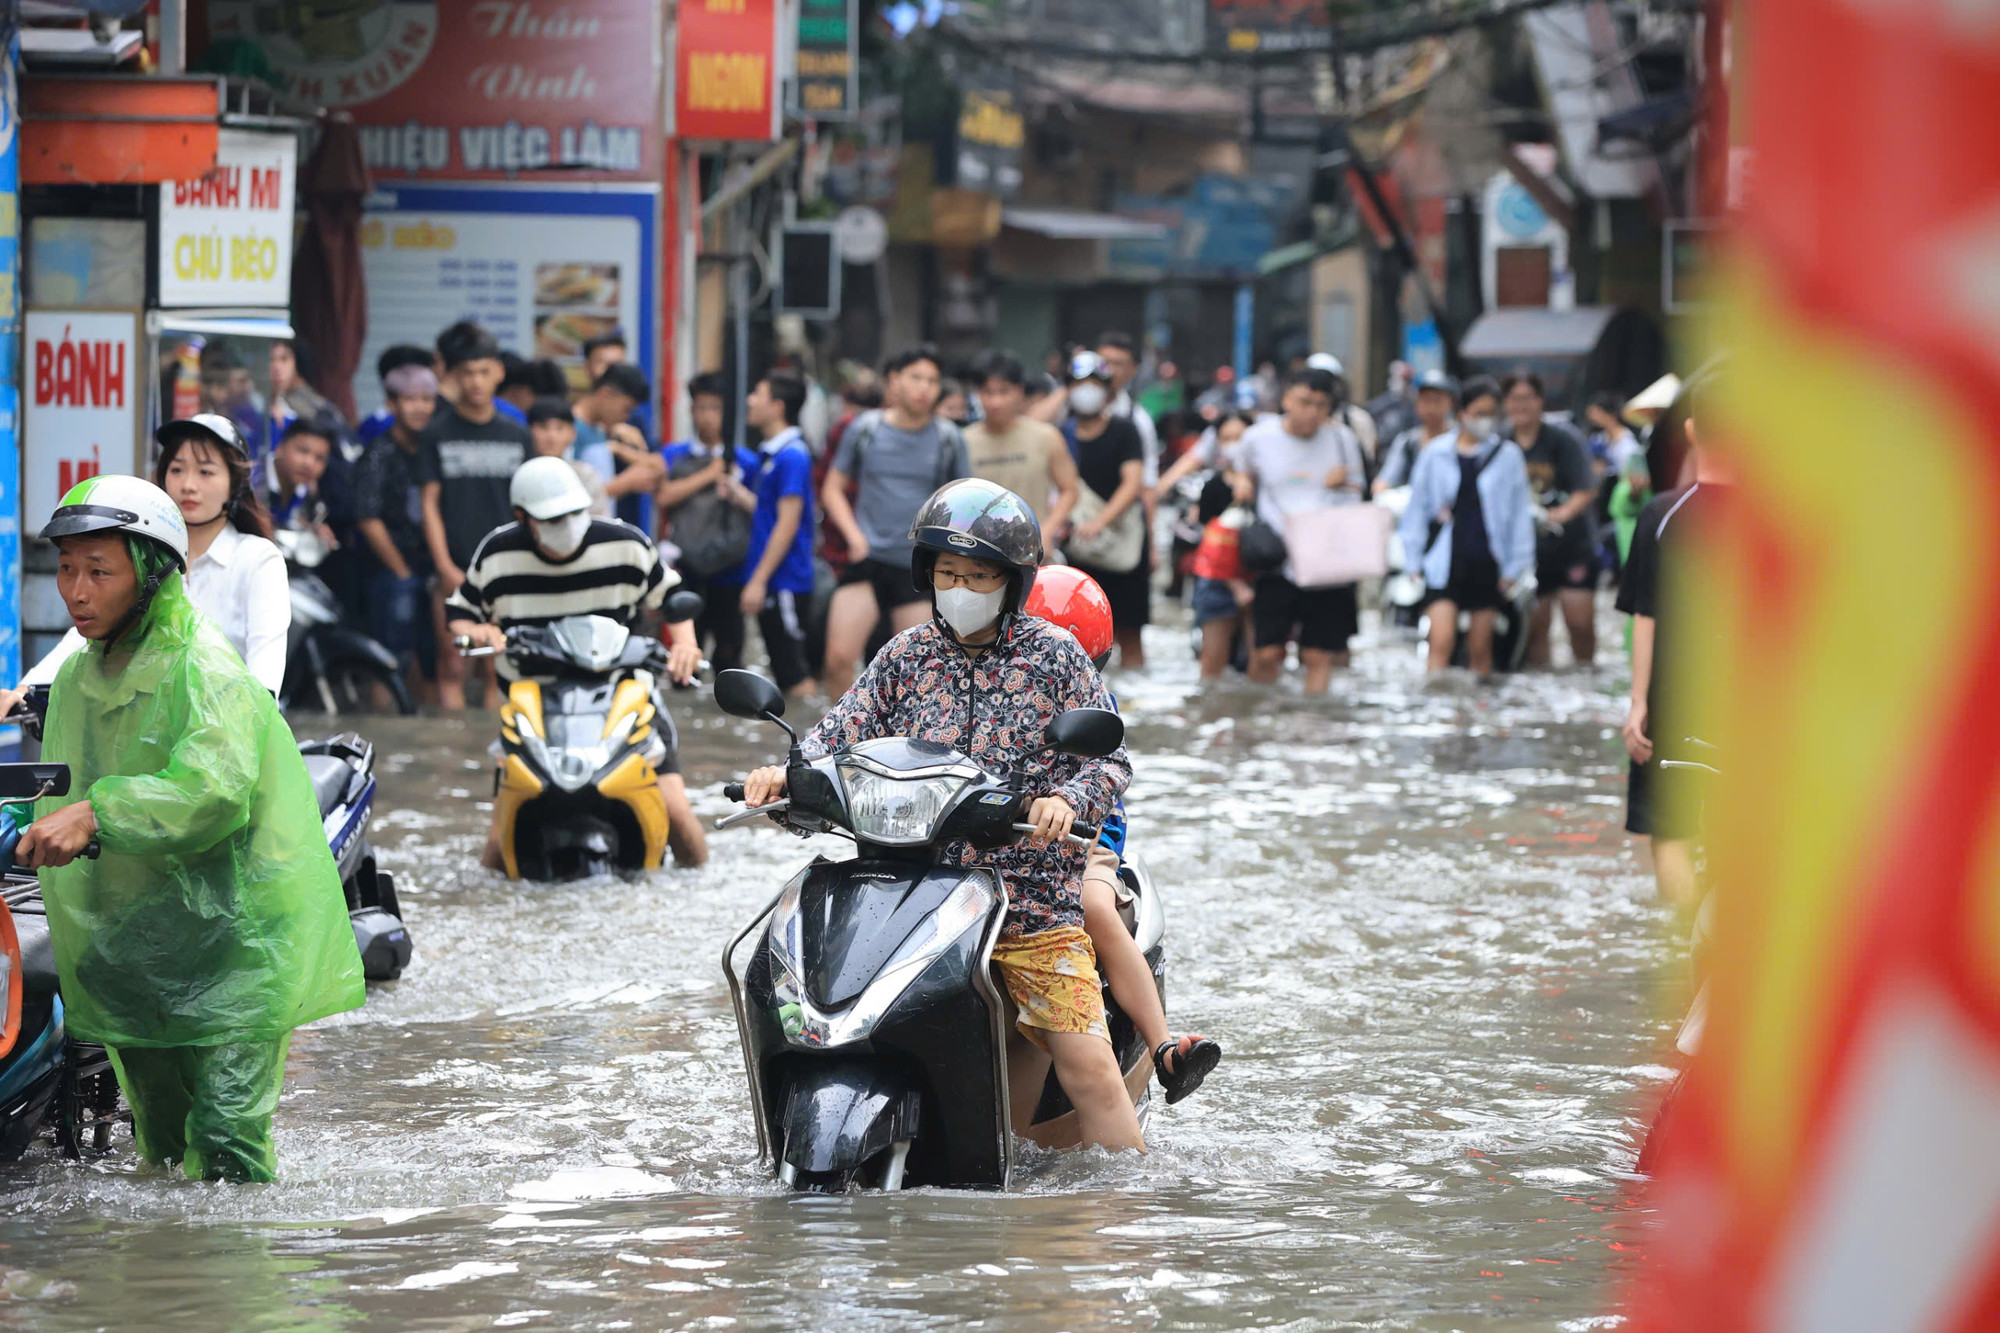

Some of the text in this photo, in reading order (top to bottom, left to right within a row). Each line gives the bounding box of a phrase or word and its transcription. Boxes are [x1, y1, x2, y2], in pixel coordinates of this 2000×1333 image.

[357, 119, 449, 177] HIỆU
[461, 119, 551, 178] VIỆC
[560, 119, 642, 169] LÀM
[35, 323, 125, 408] BÁNH
